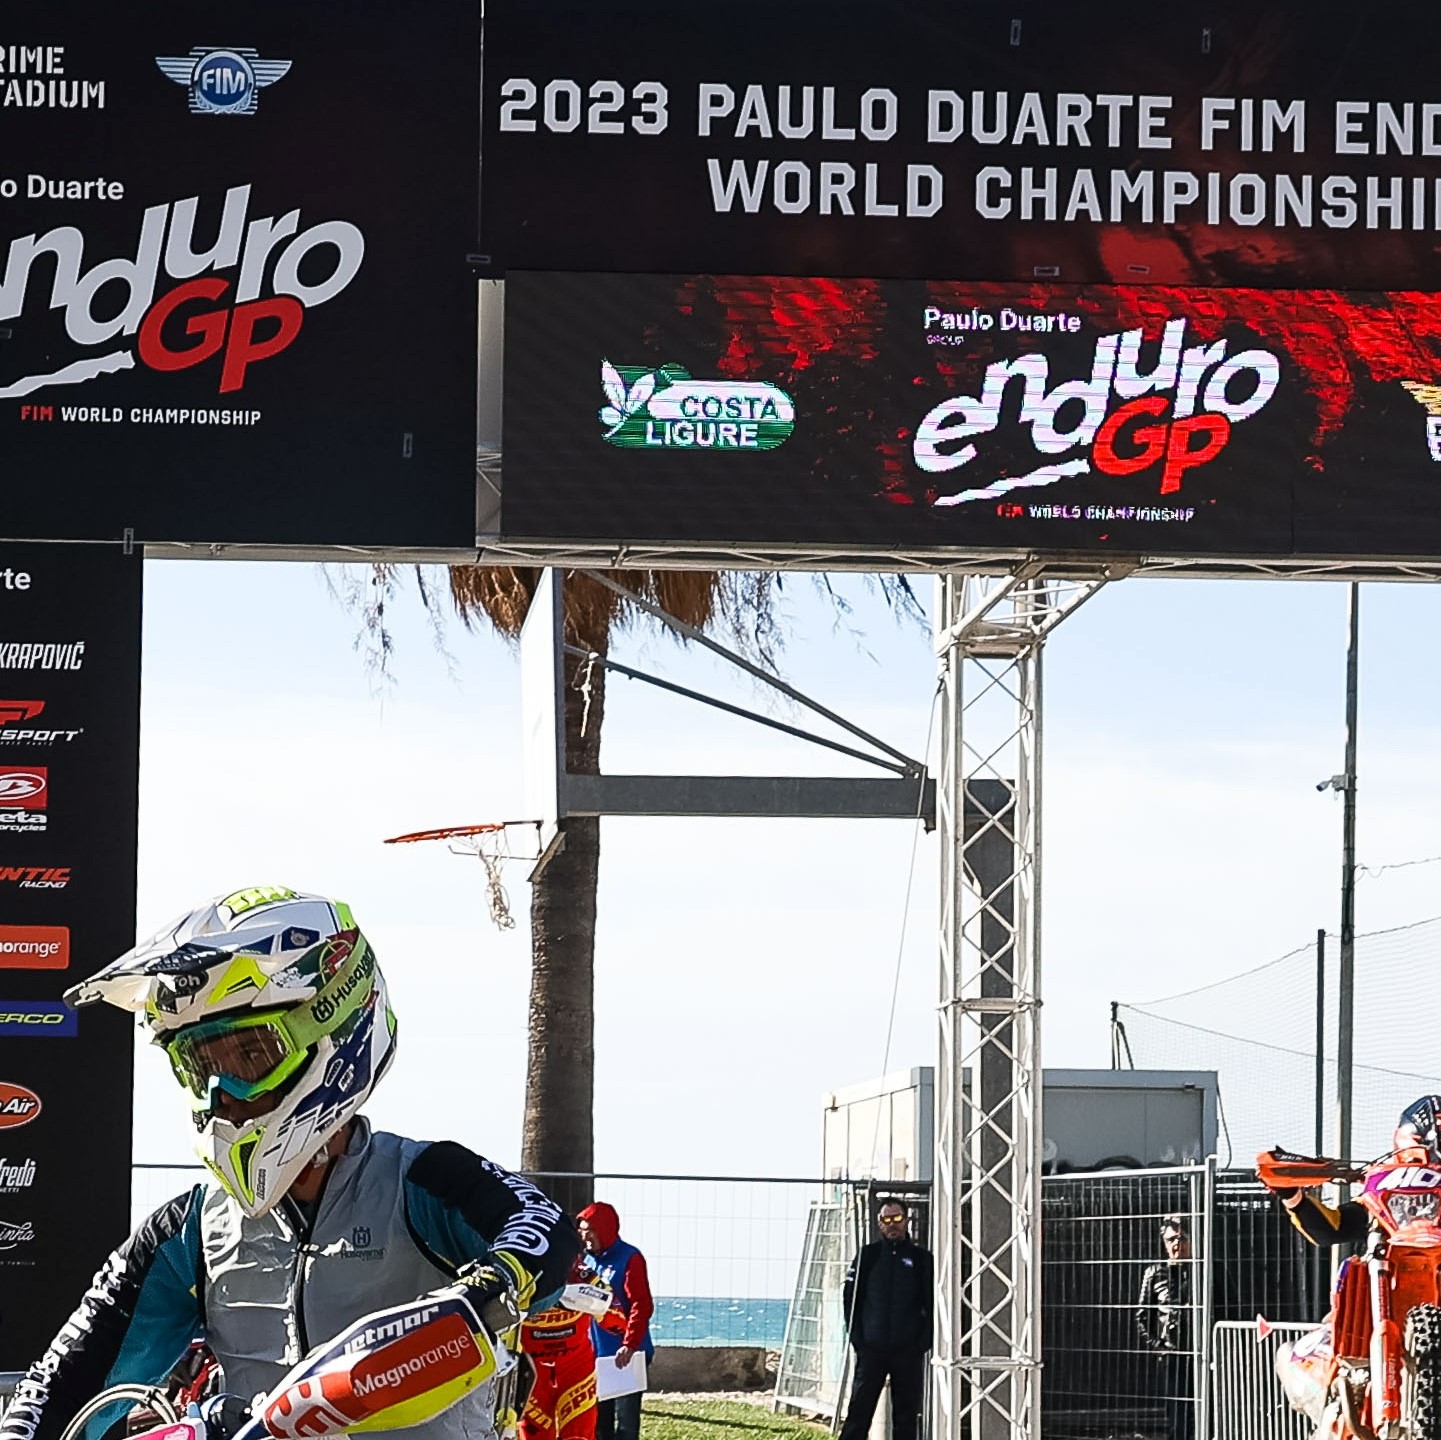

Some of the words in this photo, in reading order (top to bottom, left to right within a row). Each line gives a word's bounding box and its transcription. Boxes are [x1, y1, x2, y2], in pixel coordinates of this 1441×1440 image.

[201, 66, 246, 96] FIM
[499, 79, 671, 137] 2023
[698, 83, 899, 145] PAULO
[926, 90, 1173, 151] DUARTE
[1200, 97, 1306, 155] FIM
[27, 174, 124, 201] Duarte
[707, 159, 942, 219] WORLD
[923, 306, 994, 331] Paulo
[1001, 309, 1082, 333] Duarte
[138, 278, 304, 393] GP
[680, 395, 779, 419] COSTA
[913, 317, 1280, 473] enduro
[21, 406, 53, 421] FIM
[61, 407, 123, 423] WORLD
[130, 408, 261, 426] CHAMPIONSHIP
[646, 421, 758, 447] LIGURE
[1092, 395, 1231, 495] GP
[19, 880, 67, 888] RACING
[4, 1097, 35, 1115] Air
[355, 1334, 470, 1397] Magnorange
